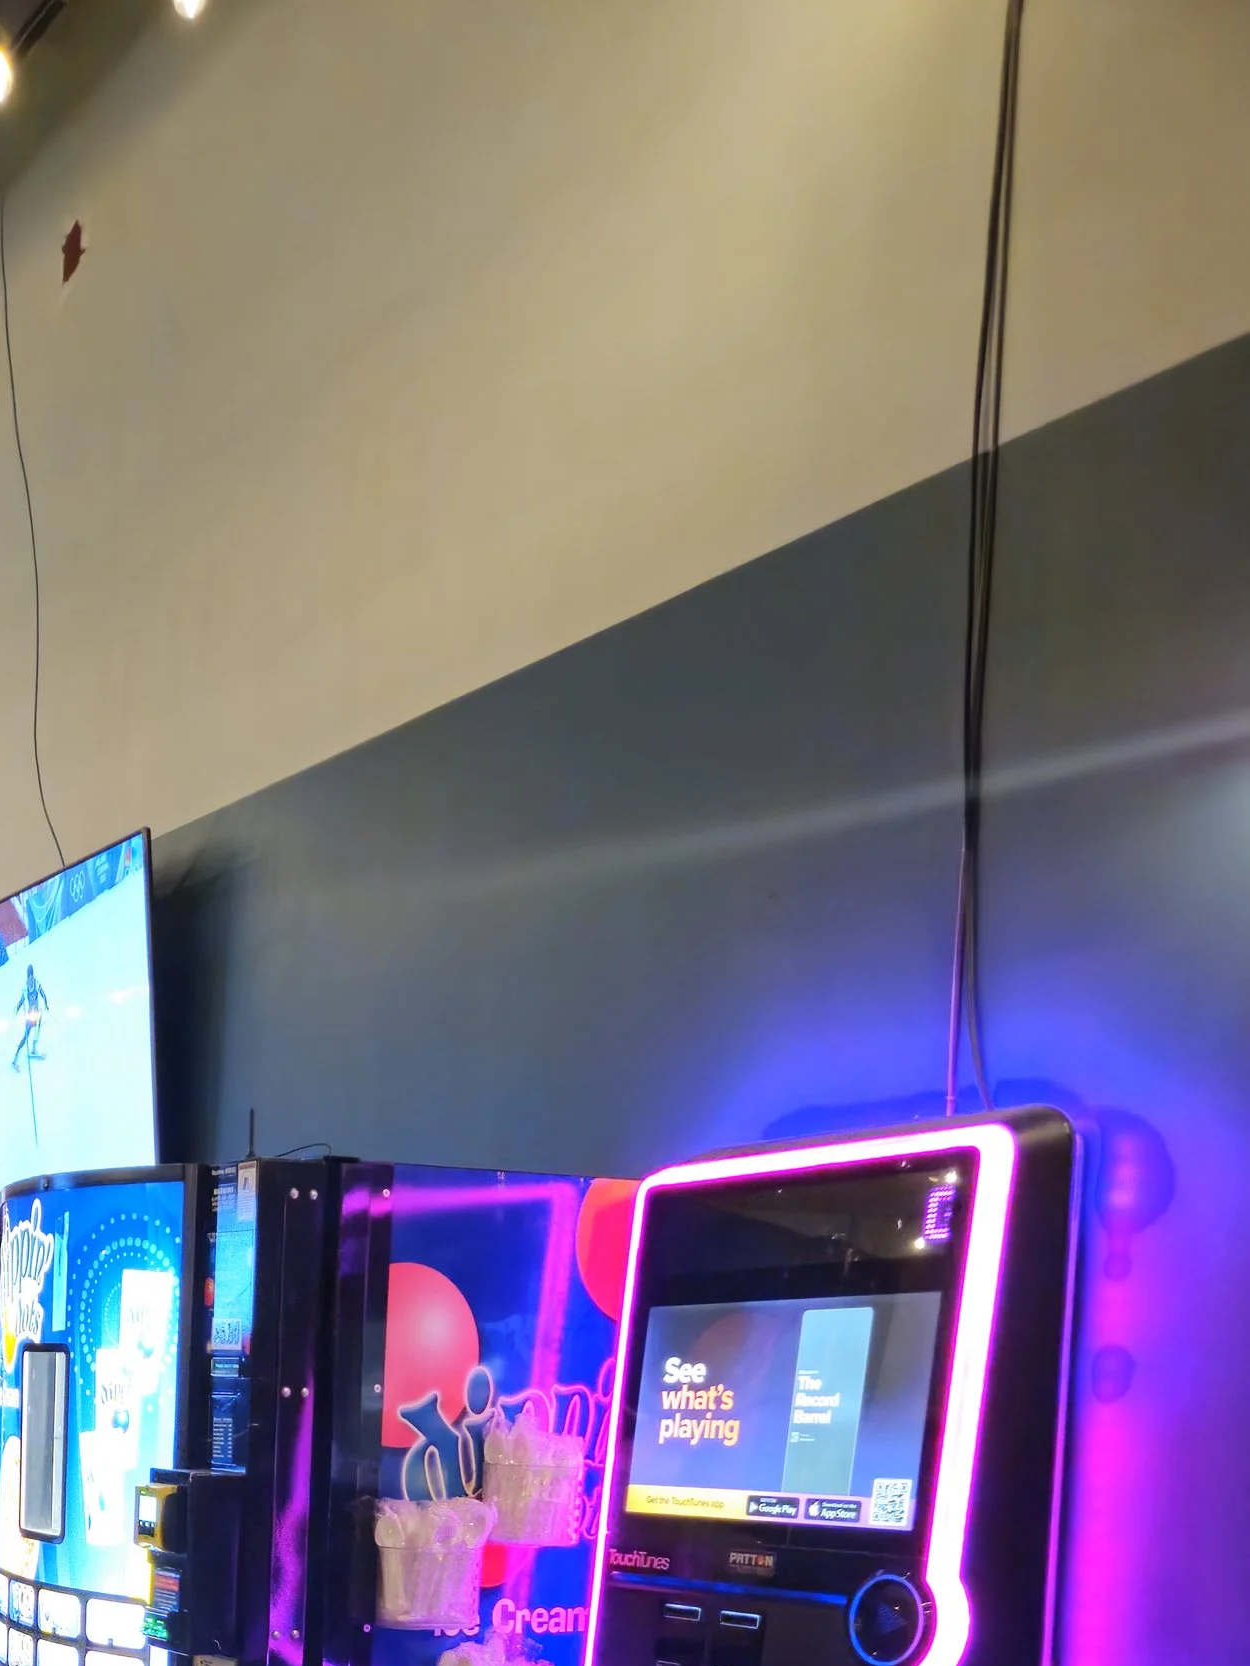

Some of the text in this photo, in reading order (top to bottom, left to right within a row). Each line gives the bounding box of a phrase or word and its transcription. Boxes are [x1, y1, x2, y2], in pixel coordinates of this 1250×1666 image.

[663, 1356, 707, 1384] See
[798, 1376, 822, 1391] The
[661, 1384, 734, 1411] what's
[795, 1392, 840, 1407] Record
[793, 1409, 831, 1424] Barrel
[658, 1411, 741, 1446] playing
[646, 1496, 658, 1504] Get
[671, 1497, 709, 1507] TouchTunes
[711, 1501, 724, 1509] app
[759, 1504, 798, 1516] Google Play
[820, 1508, 857, 1519] App Store
[609, 1549, 670, 1570] TouchTunes
